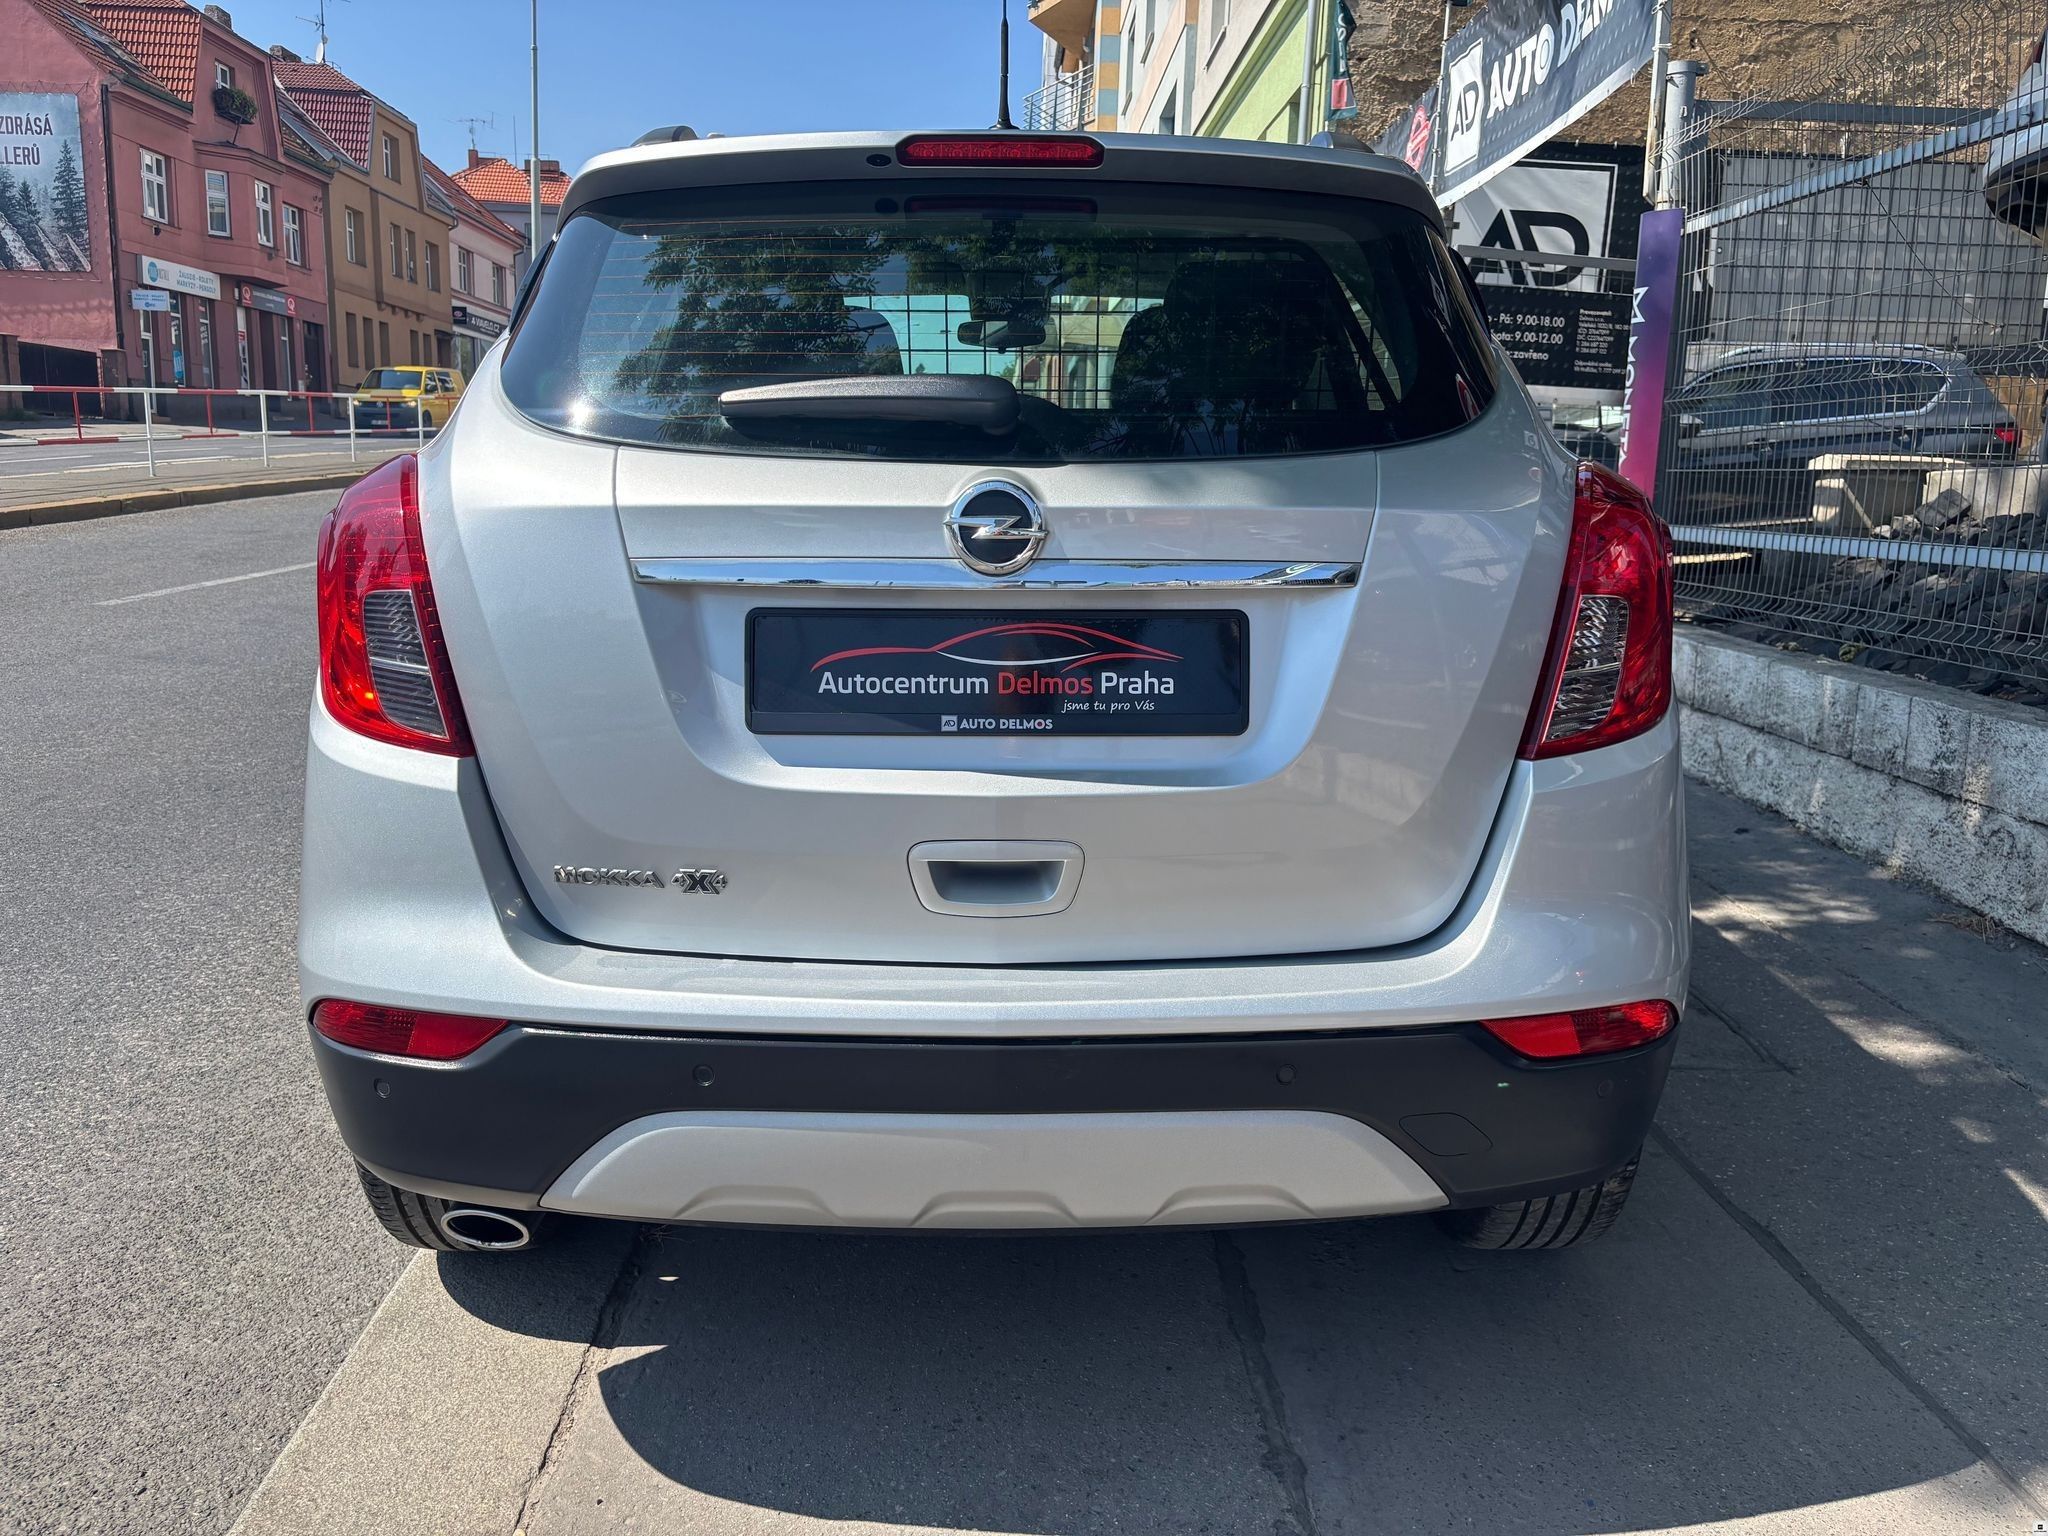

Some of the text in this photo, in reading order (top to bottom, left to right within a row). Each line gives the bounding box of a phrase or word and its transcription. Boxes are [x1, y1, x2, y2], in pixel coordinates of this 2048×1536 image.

[1486, 23, 1555, 119] AUTO
[1499, 312, 1514, 324] Pá:
[1516, 314, 1565, 328] 9.00-18.00
[1514, 331, 1564, 345] 9.00-12.00
[1513, 349, 1549, 361] zavřeno
[818, 670, 1174, 695] Autocentrum Delmos Praha
[1061, 699, 1155, 714] jsme tu pro Vás
[959, 718, 996, 730] AUTO
[1000, 718, 1053, 730] DELMOS
[553, 865, 665, 889] MOKKA
